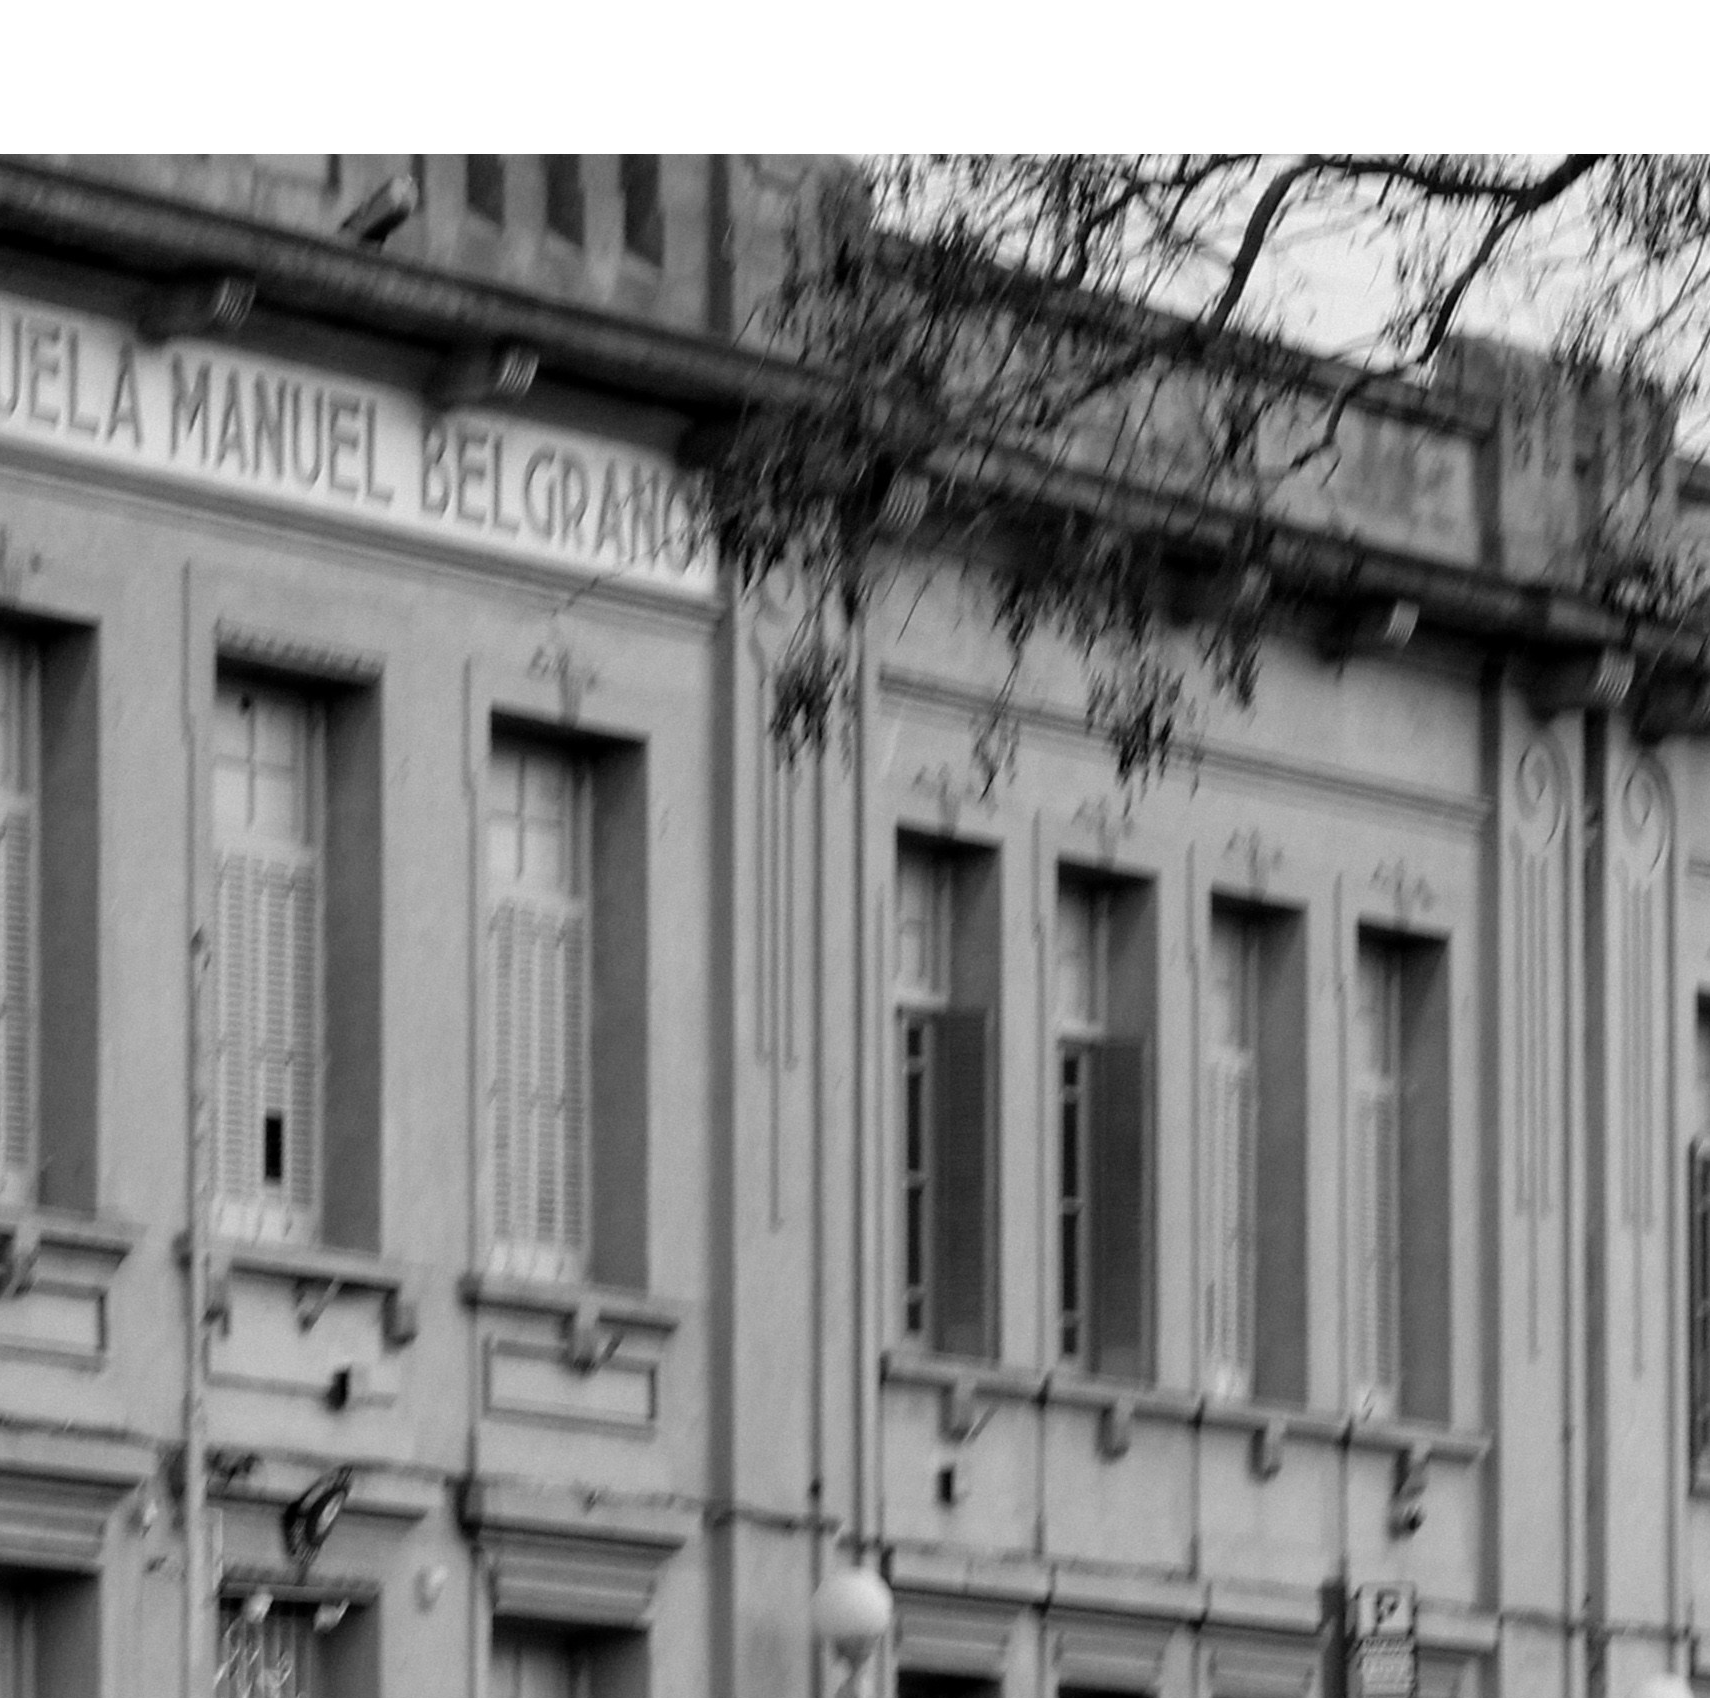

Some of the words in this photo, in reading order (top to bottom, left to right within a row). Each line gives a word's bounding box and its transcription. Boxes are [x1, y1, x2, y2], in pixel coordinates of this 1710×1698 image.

[167, 350, 395, 508] MANUEL
[419, 420, 701, 576] BELGRANO
[1372, 1588, 1400, 1637] P
